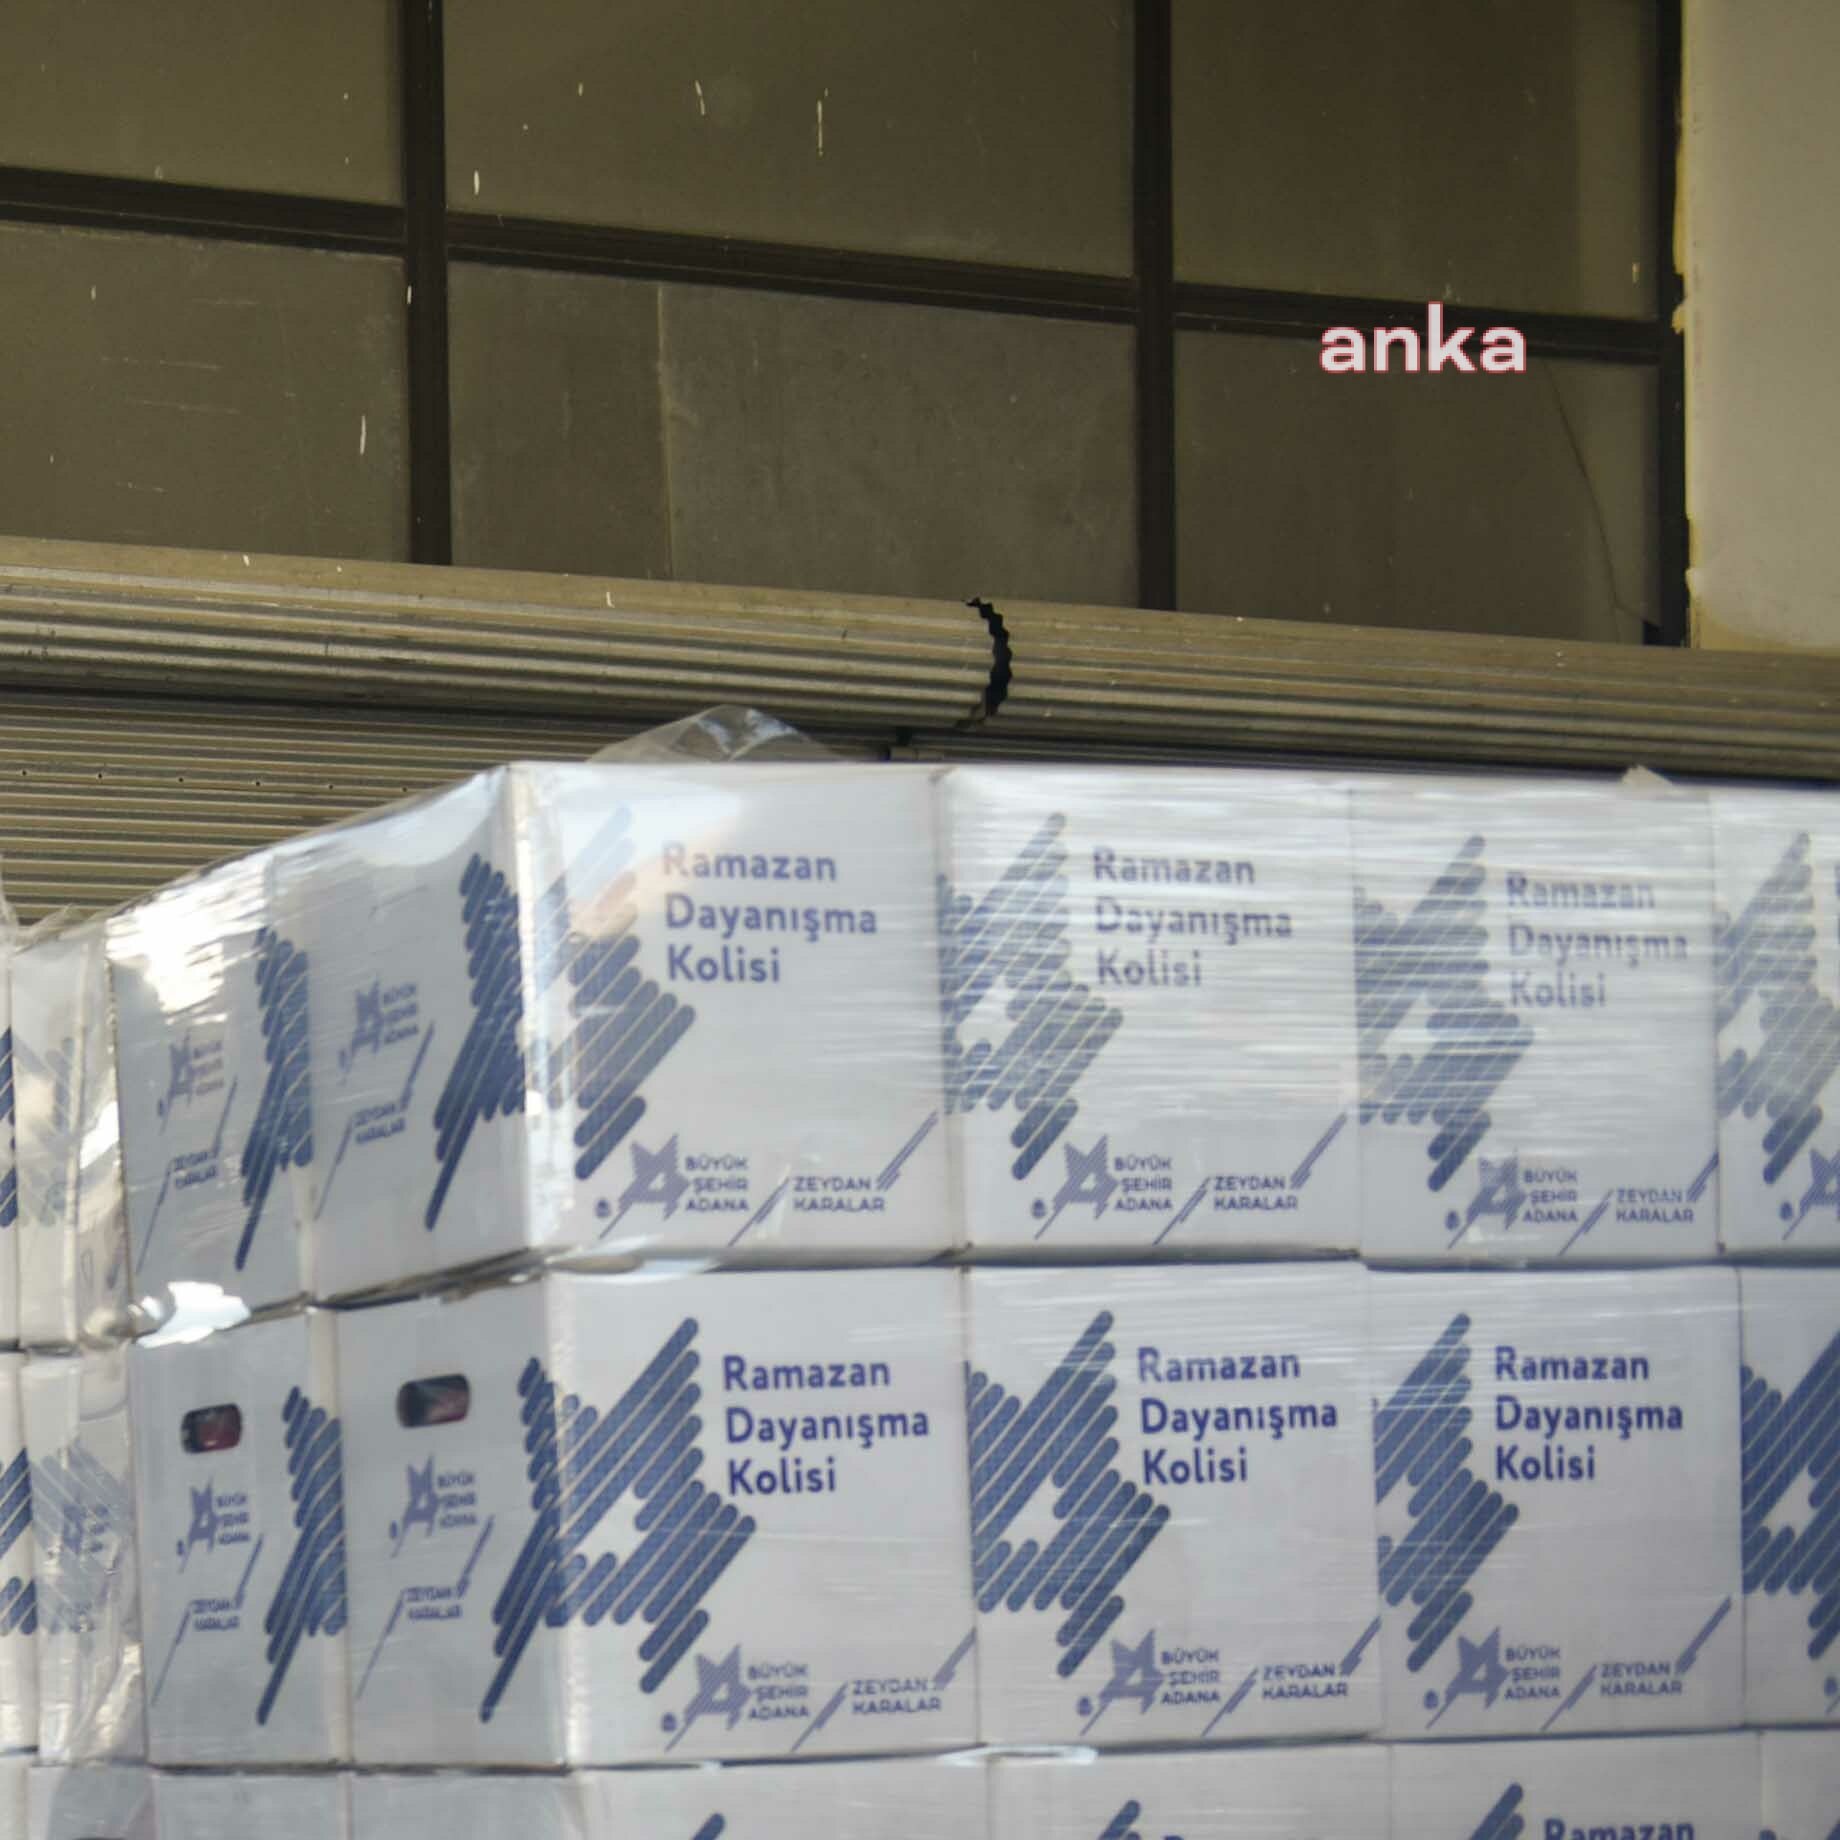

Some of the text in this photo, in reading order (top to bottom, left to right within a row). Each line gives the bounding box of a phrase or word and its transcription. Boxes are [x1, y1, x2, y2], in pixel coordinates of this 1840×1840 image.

[664, 846, 836, 880] Ramazan
[1092, 848, 1255, 884] Ramazan
[664, 892, 877, 942] Dayanışma
[1093, 896, 1294, 945] Dayanışma
[668, 944, 779, 982] Kolisi
[1096, 949, 1201, 986] Kolisi
[723, 1355, 889, 1391] Ramazan
[1138, 1347, 1301, 1382] Ramazan
[1495, 1346, 1648, 1381] Ramazan
[726, 1407, 928, 1451] Dayanışma
[1141, 1398, 1337, 1441] Dayanışma
[1496, 1395, 1682, 1440] Dayanışma
[729, 1457, 835, 1496] Kolisi
[1144, 1447, 1246, 1485] Kolisi
[1496, 1445, 1594, 1480] Kolisi
